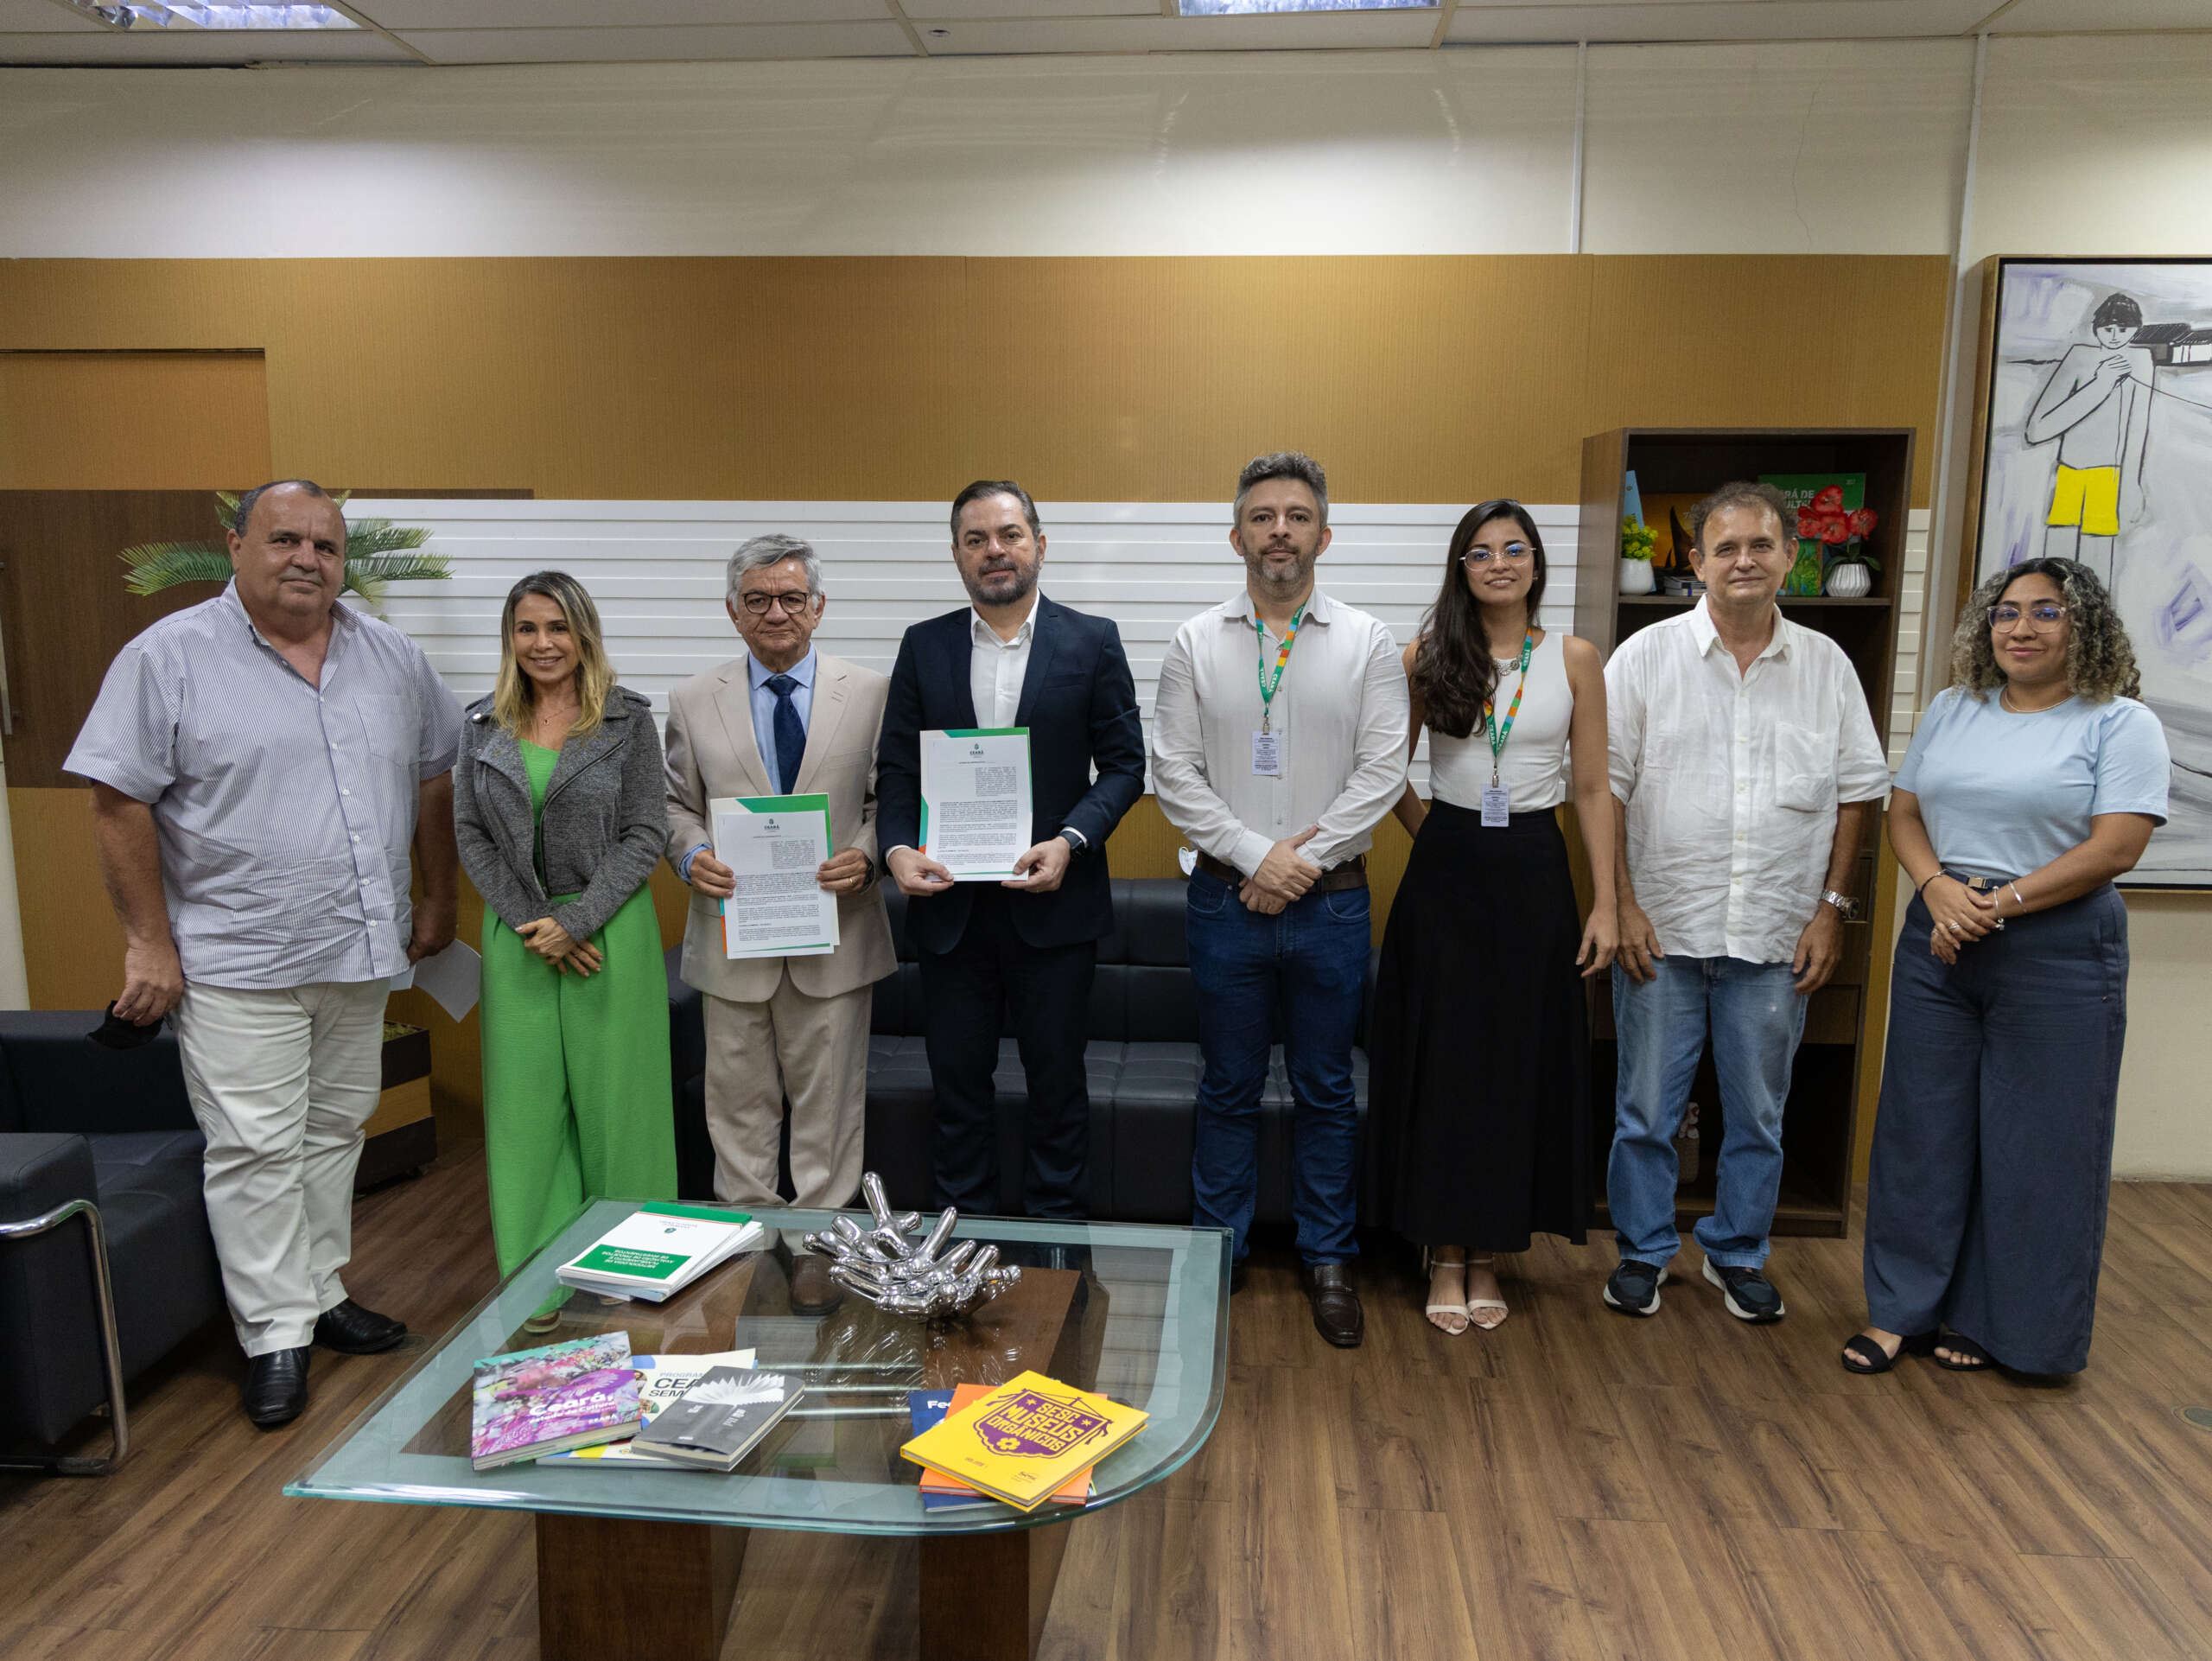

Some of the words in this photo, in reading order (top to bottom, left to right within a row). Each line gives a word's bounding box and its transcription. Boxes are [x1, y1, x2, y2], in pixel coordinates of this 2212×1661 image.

[1000, 1404, 1084, 1442] MUSEUS
[1036, 1403, 1081, 1422] SESC
[986, 1415, 1066, 1452] ORGÂNICOS
